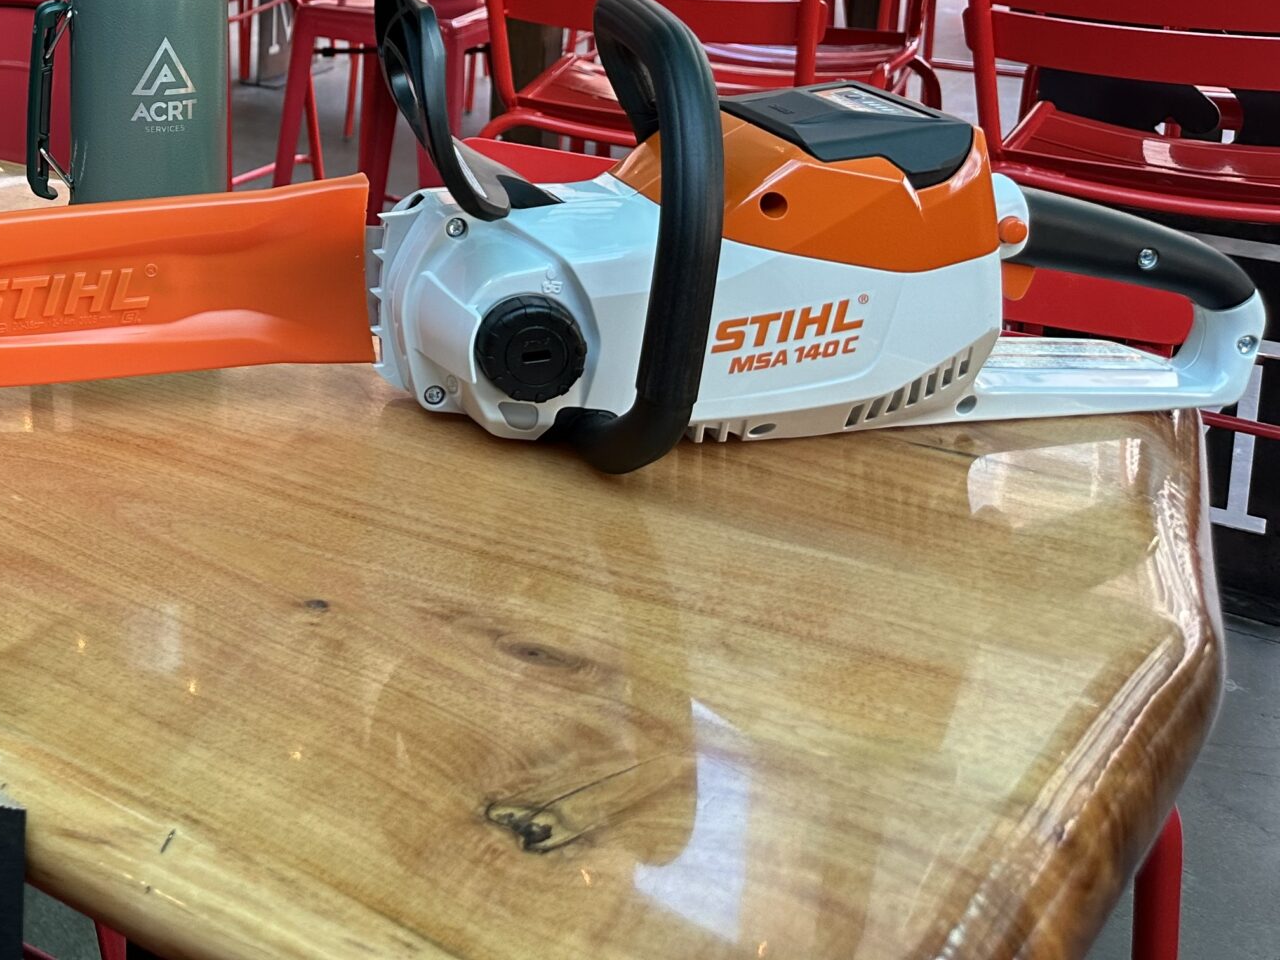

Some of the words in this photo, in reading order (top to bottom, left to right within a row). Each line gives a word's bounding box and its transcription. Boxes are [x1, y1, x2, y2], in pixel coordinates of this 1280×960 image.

[130, 98, 198, 122] ACRT
[144, 124, 186, 133] SERVICES
[728, 349, 788, 375] MSA
[794, 339, 840, 364] 140
[841, 335, 860, 355] C
